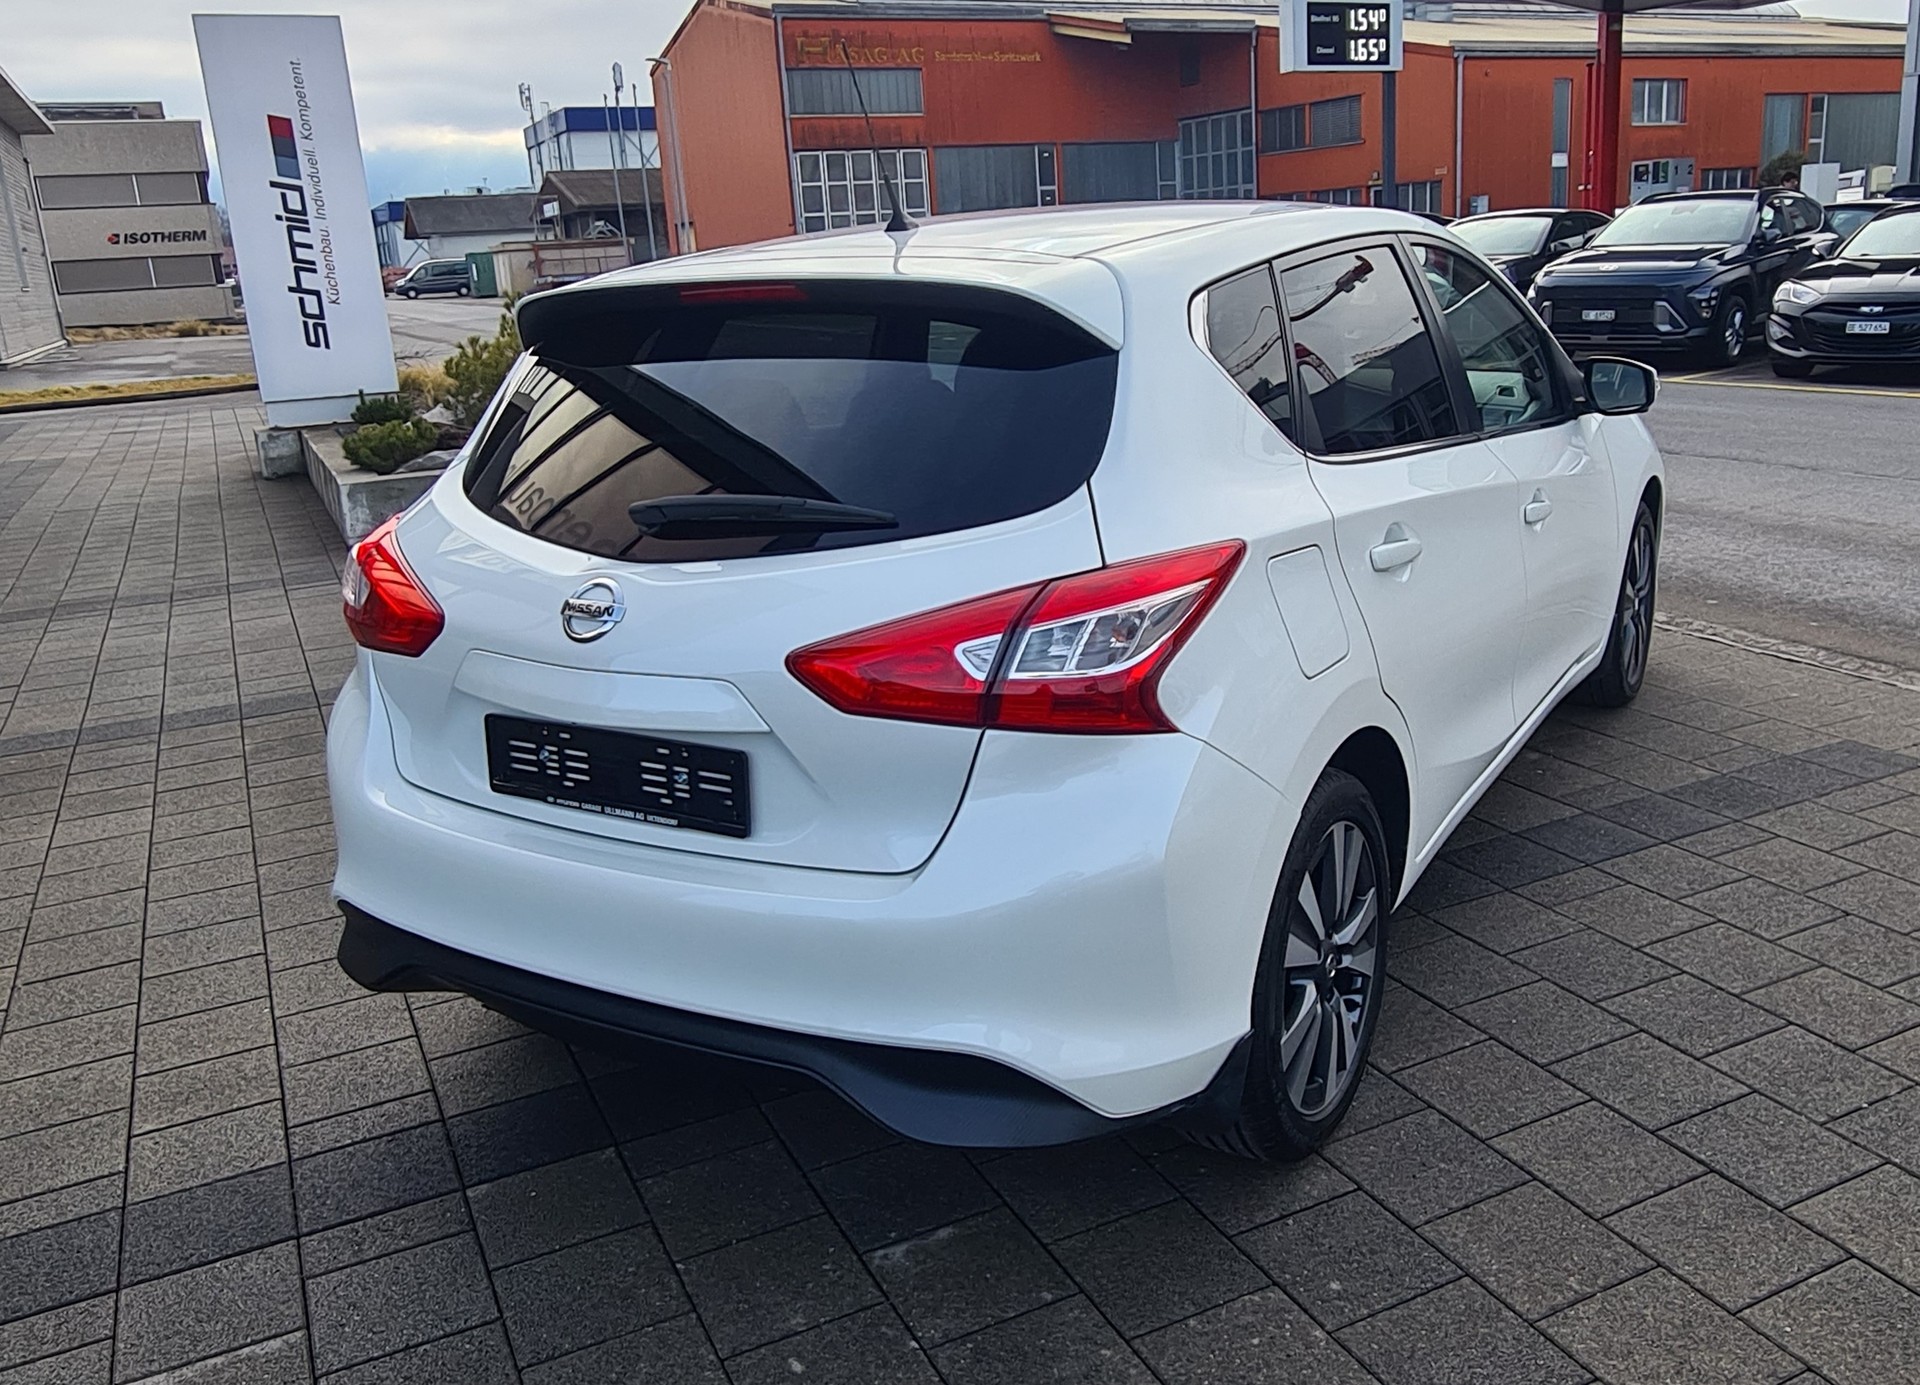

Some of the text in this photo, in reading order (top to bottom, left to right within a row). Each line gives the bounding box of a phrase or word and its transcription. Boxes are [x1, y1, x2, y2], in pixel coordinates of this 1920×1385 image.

[897, 46, 925, 63] AG
[1674, 163, 1693, 175] 1 2
[289, 58, 341, 306] Küchenbau. Individuell. Kompetent.
[123, 229, 207, 245] ISOTHERM
[269, 180, 331, 350] schmid
[560, 599, 615, 618] NISSAN
[604, 806, 635, 818] ULLMANN
[635, 811, 645, 821] AG
